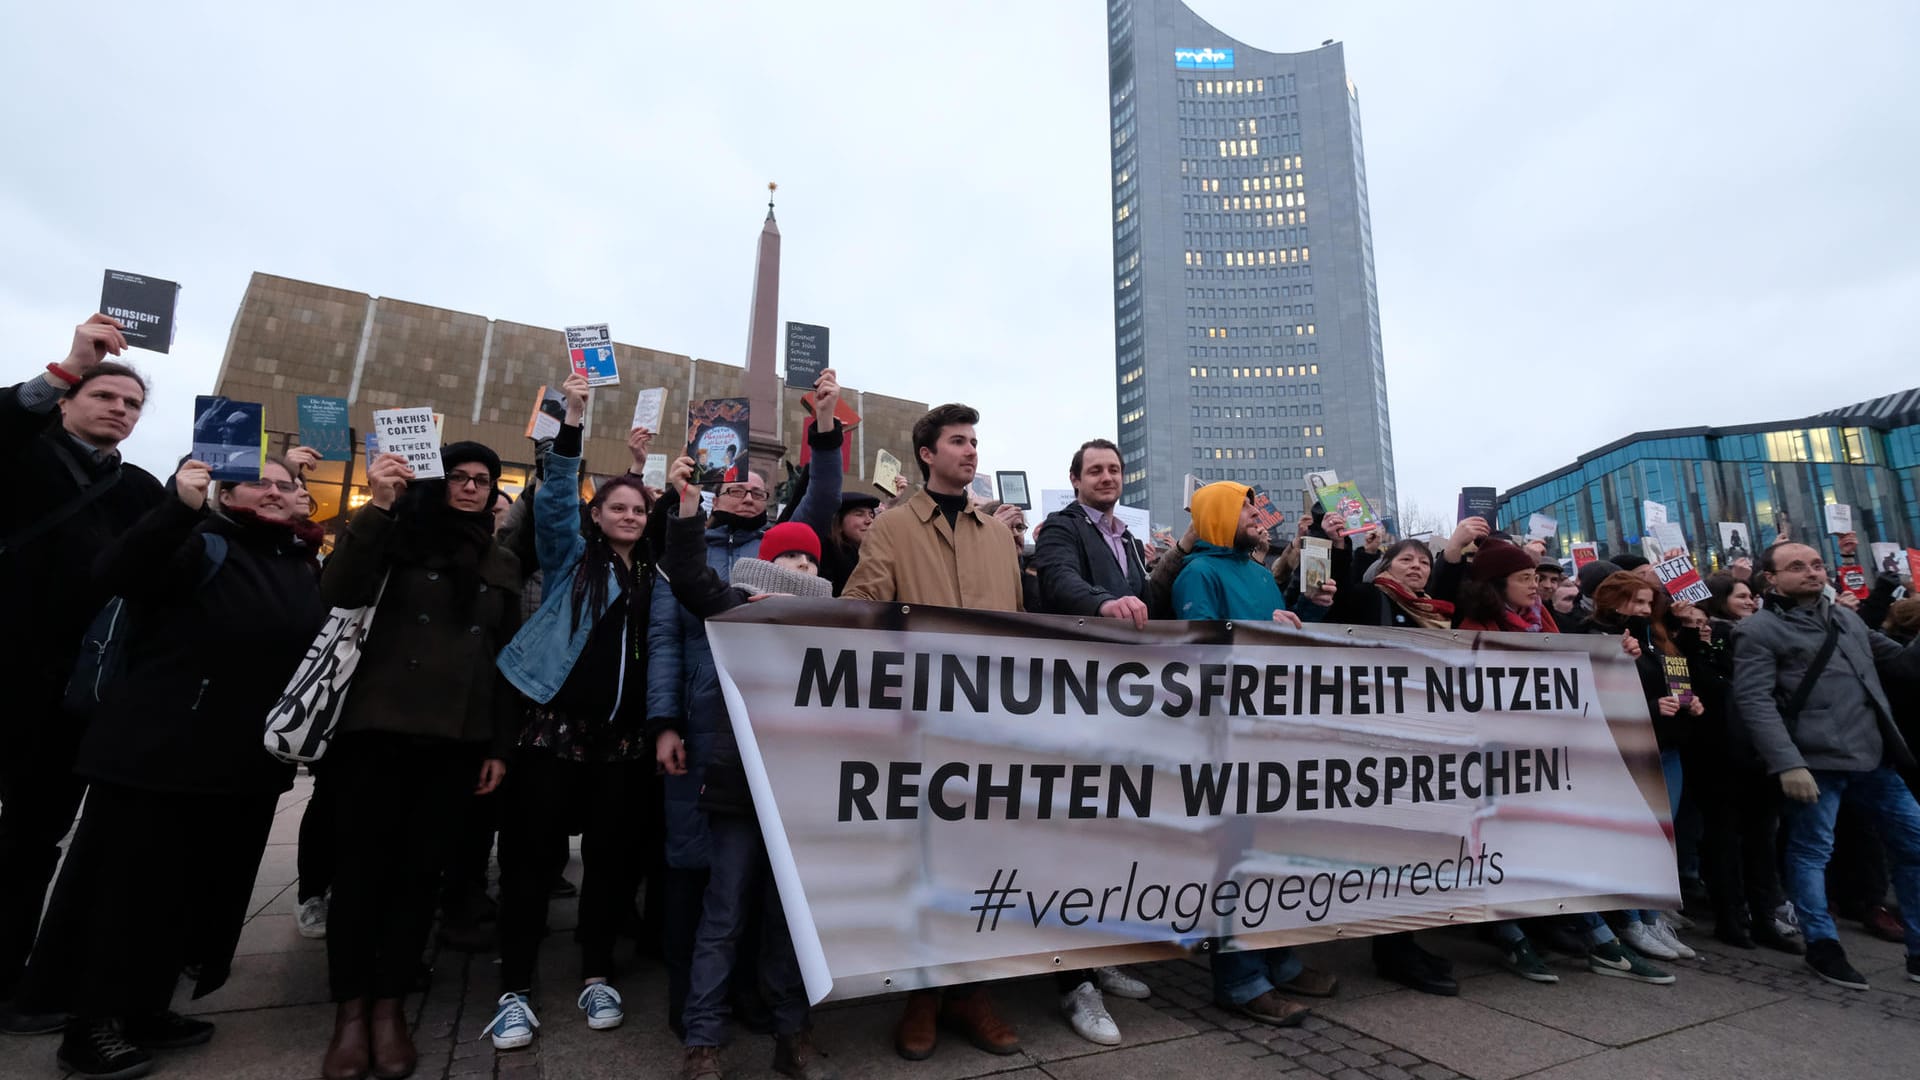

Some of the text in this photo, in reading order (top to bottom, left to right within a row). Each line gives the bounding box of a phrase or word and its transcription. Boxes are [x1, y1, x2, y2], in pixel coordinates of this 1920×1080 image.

[107, 306, 160, 325] VORSICHT
[113, 316, 139, 330] OLK!
[569, 340, 611, 349] Experiment
[380, 414, 430, 425] TA-NEHISI
[388, 425, 427, 436] COATES
[389, 442, 432, 453] BETWEEN
[407, 452, 437, 461] WORLD
[418, 463, 431, 471] ME
[1655, 557, 1692, 583] JETZT
[1665, 656, 1687, 666] PUSSY
[1666, 665, 1690, 677] RIOT!
[794, 647, 1588, 718] MEINUNGSFREIHEIT NUTZEN,
[838, 746, 1571, 822] RECHTEN WIDERSPRECHEN!
[970, 835, 1504, 934] #verlagegegenrechts
